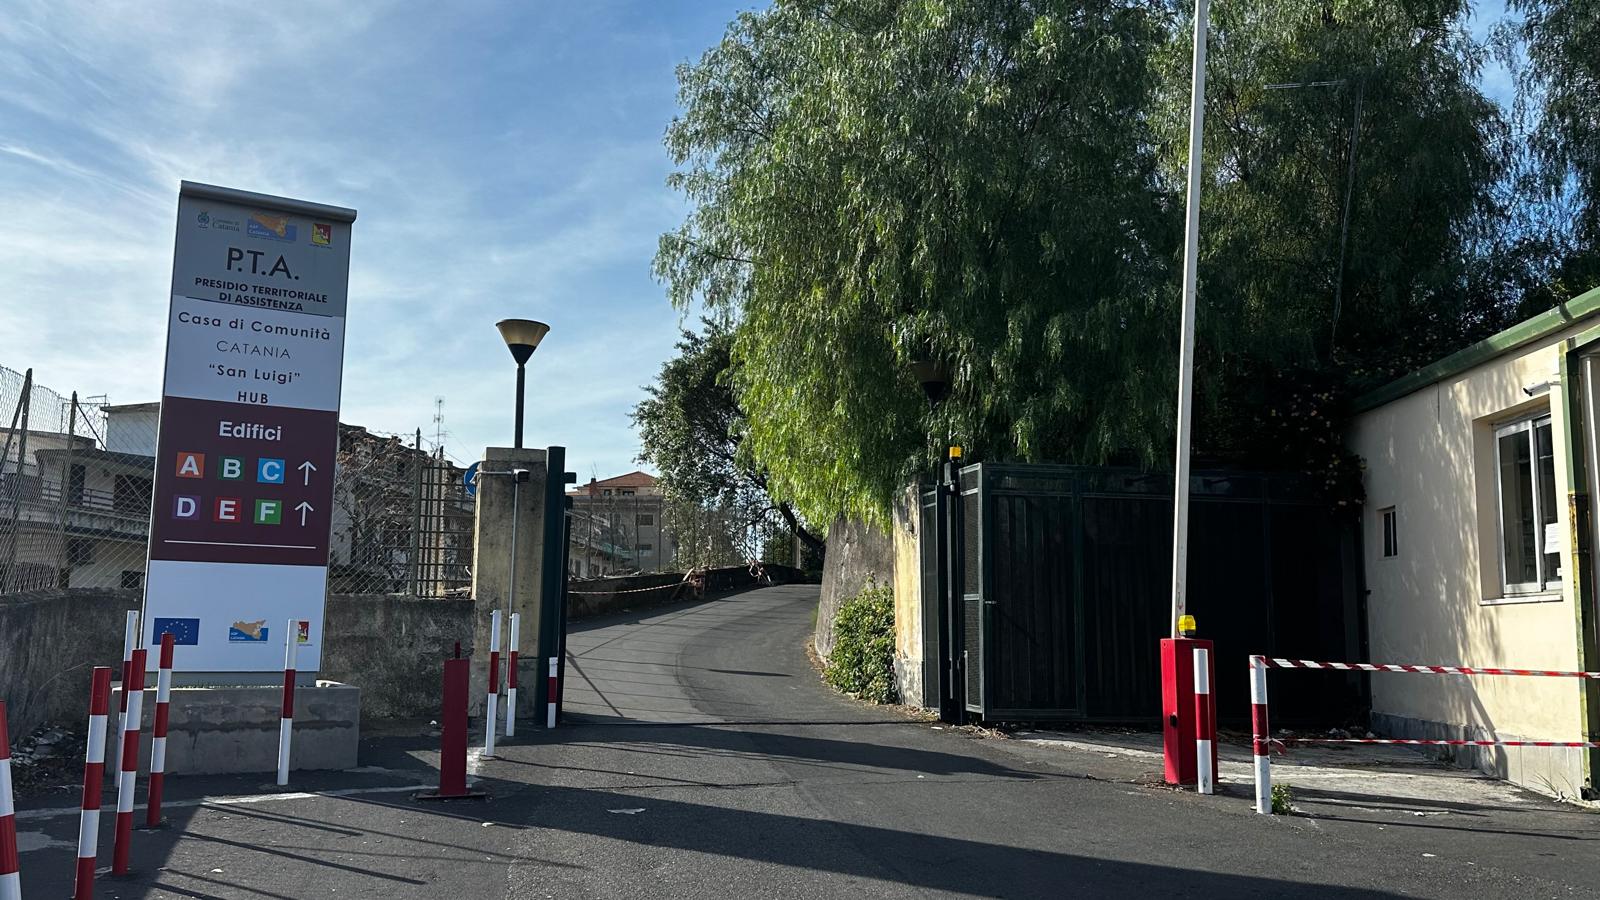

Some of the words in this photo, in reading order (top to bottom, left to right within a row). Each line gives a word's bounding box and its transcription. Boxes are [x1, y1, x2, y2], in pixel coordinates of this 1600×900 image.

[226, 247, 300, 280] P.T.A.
[195, 277, 249, 292] PRESIDIO
[252, 285, 328, 303] TERRITORIALE
[218, 292, 231, 302] DI
[235, 294, 303, 311] ASSISTENZA
[178, 311, 221, 327] Casa
[229, 318, 244, 330] di
[251, 321, 331, 340] Comunità
[216, 340, 291, 359] CATANIA
[209, 364, 247, 378] “San
[254, 368, 300, 385] Luigi”
[237, 391, 268, 404] HUB
[219, 420, 282, 441] Edifici
[179, 455, 199, 476] A
[223, 458, 241, 478] B
[262, 461, 281, 481] C
[176, 497, 196, 517] D
[219, 500, 236, 520] E
[260, 502, 277, 521] F
